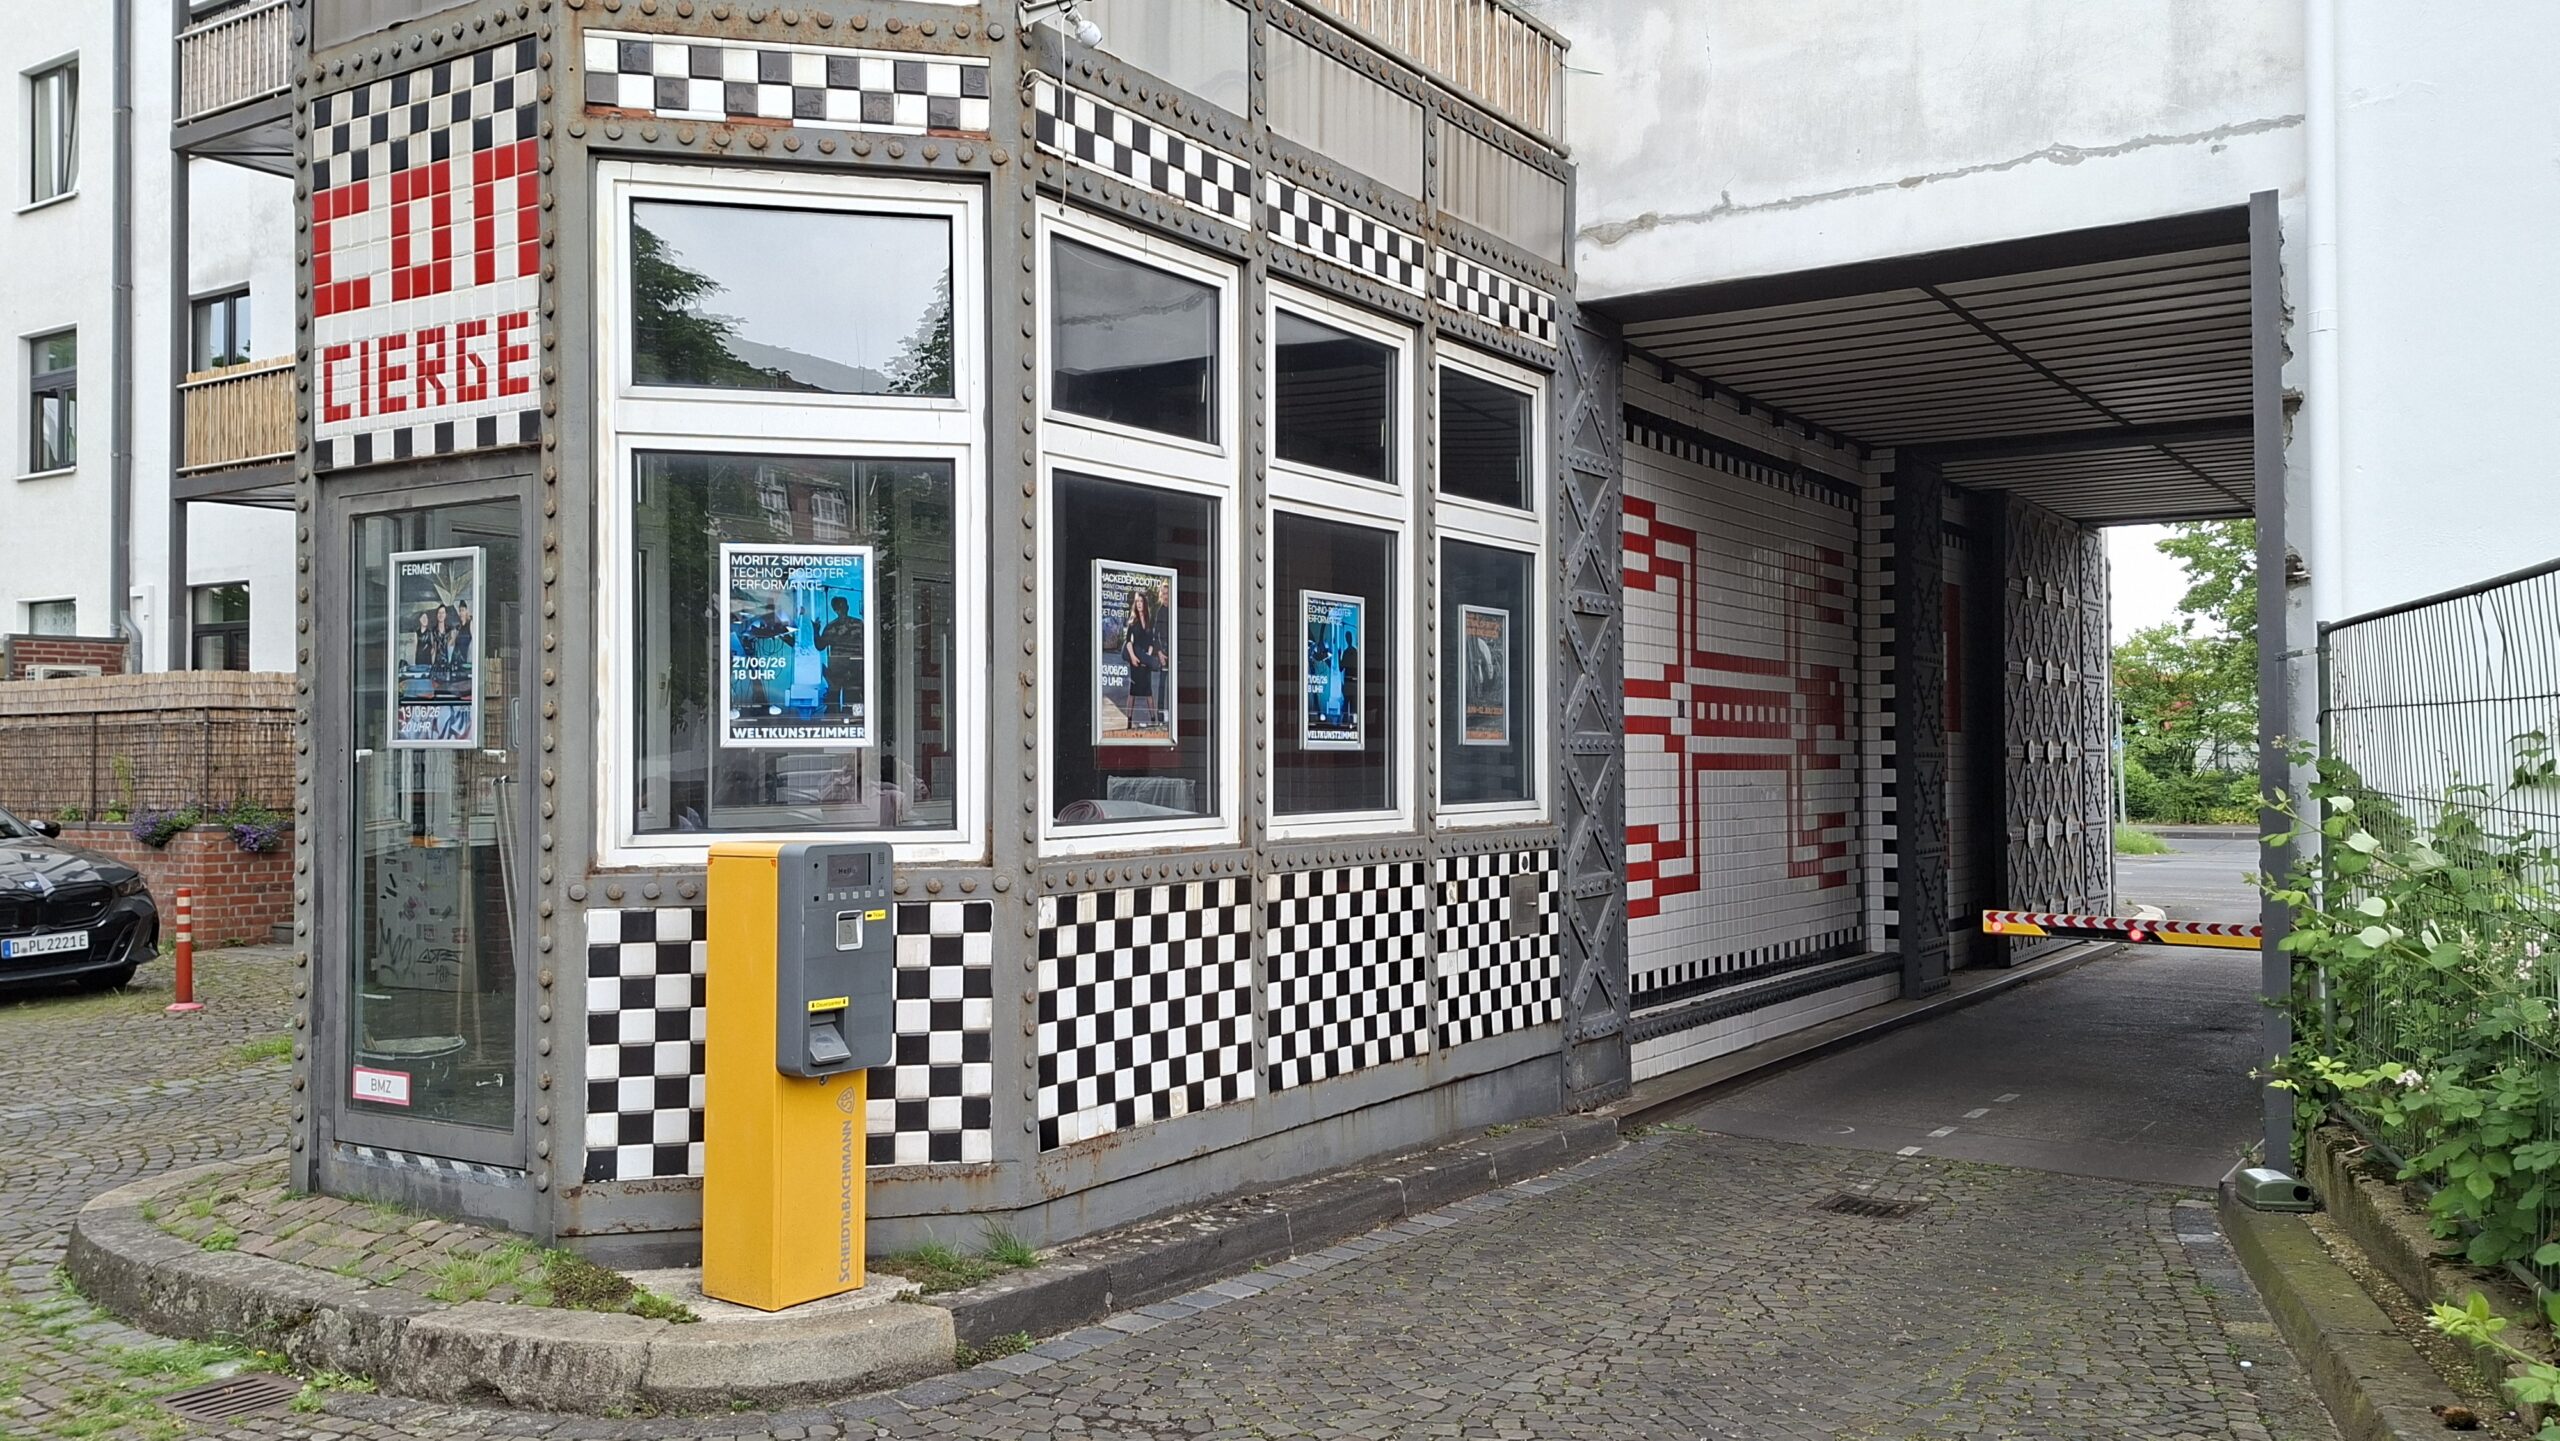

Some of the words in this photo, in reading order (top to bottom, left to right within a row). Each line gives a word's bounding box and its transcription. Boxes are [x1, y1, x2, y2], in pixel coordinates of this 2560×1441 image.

[323, 311, 529, 423] CIERGE
[731, 555, 779, 566] MORITZ
[781, 555, 822, 566] SIMON
[824, 556, 859, 566] GEIST
[402, 562, 441, 576] FERMENT
[732, 567, 849, 579] TECHNO-ROBOTER-
[732, 579, 823, 591] PERFORMANCE
[732, 657, 786, 669] 21/06/26
[732, 669, 747, 680] 18
[749, 669, 775, 680] UHR
[1102, 665, 1129, 676] 3/06/26
[1108, 677, 1124, 687] UHR
[400, 706, 440, 720] 13/06/26
[401, 721, 412, 733] 20
[413, 721, 431, 733] UHR
[732, 727, 865, 739] WELTKUNSTZIMMER
[12, 941, 20, 954] D
[370, 1077, 392, 1094] BMZ
